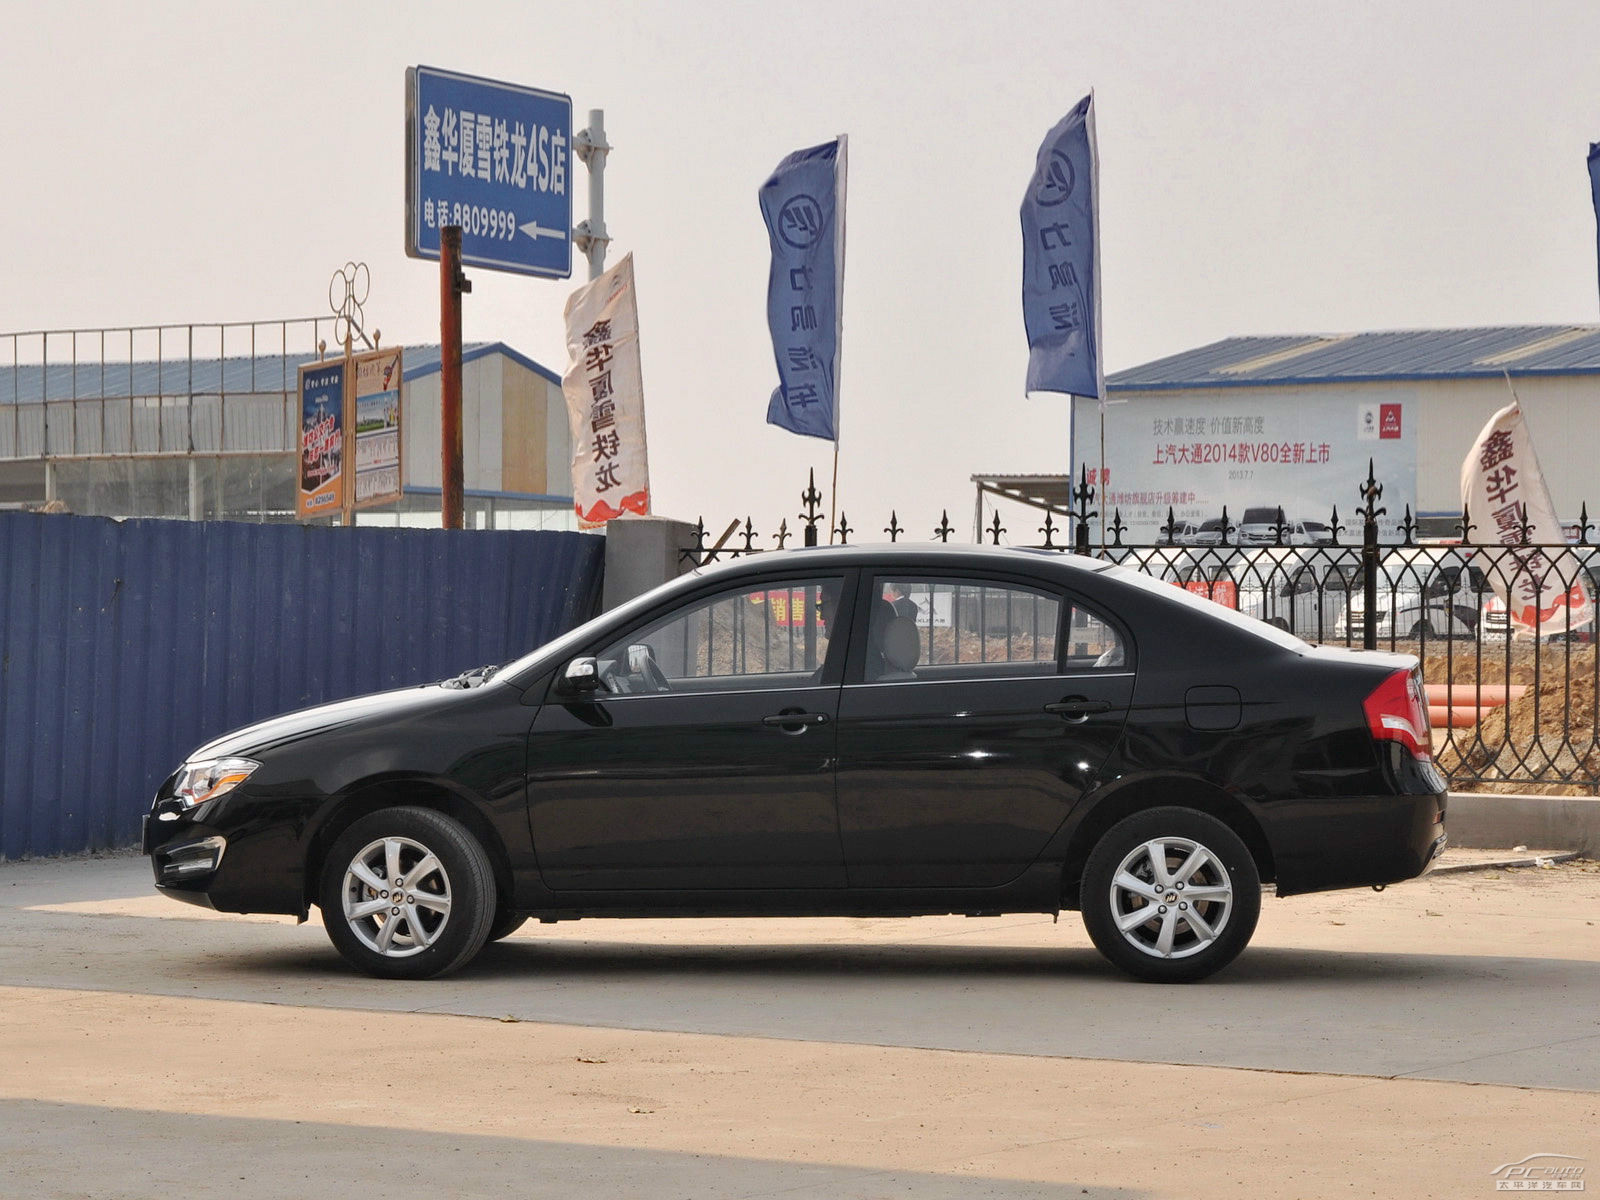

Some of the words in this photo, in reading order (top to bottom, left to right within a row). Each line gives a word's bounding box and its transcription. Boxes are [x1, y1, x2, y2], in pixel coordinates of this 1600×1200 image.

[423, 104, 566, 196] 鑫华厦雪铁龙4S店
[1210, 415, 1265, 435] 价值新高度
[1152, 441, 1331, 465] 上汽大通2014款V80全新上市
